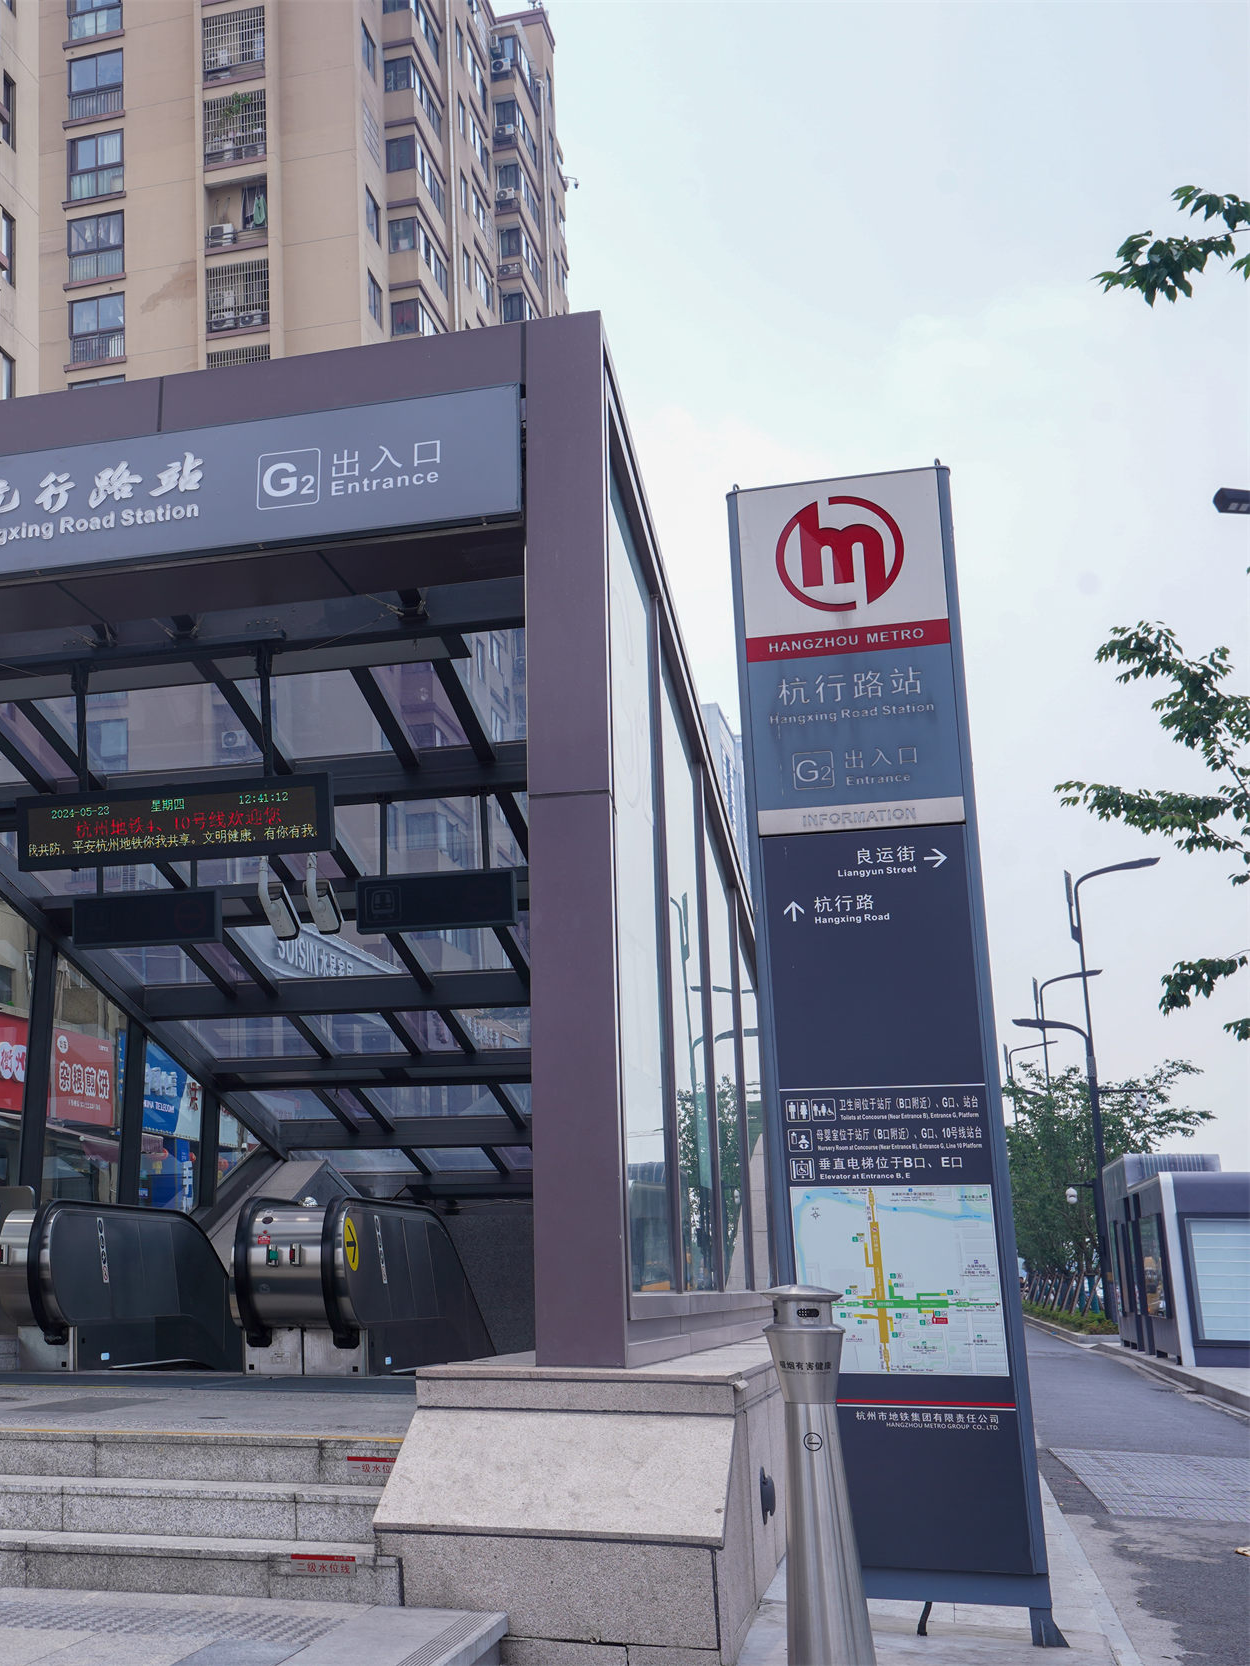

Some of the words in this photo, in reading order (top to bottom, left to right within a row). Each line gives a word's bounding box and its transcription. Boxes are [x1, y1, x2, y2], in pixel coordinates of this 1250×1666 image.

[331, 439, 441, 478] 出入口
[262, 462, 315, 497] G2
[331, 471, 439, 496] Entrance
[59, 511, 116, 534] Road
[120, 502, 199, 527] Station
[768, 633, 859, 654] HANGZHOU
[866, 627, 925, 643] METRO
[777, 666, 923, 706] 杭行路站
[769, 710, 837, 726] Hangxing
[841, 706, 878, 720] Road
[882, 702, 935, 716] Station
[844, 746, 918, 771] 出入口
[795, 758, 832, 784] G2
[846, 772, 911, 787] Entrance
[150, 797, 185, 813] 星期四
[239, 791, 289, 805] 12:41:12
[51, 805, 110, 820] 2024-05-23
[802, 807, 916, 828] INFORMATION
[856, 845, 916, 865] 良运街
[837, 867, 884, 878] Liangyun
[886, 865, 917, 875] Street
[814, 893, 874, 913] 杭行路
[814, 914, 862, 925] Hangxing
[864, 913, 890, 922] Road
[59, 1060, 110, 1100] 杂粮煎饼
[860, 1172, 895, 1180] Entrance
[896, 1172, 904, 1180] B,
[855, 1410, 999, 1424] 杭州市地铁集团有限责任公司
[296, 1562, 351, 1575] 二级水位线
